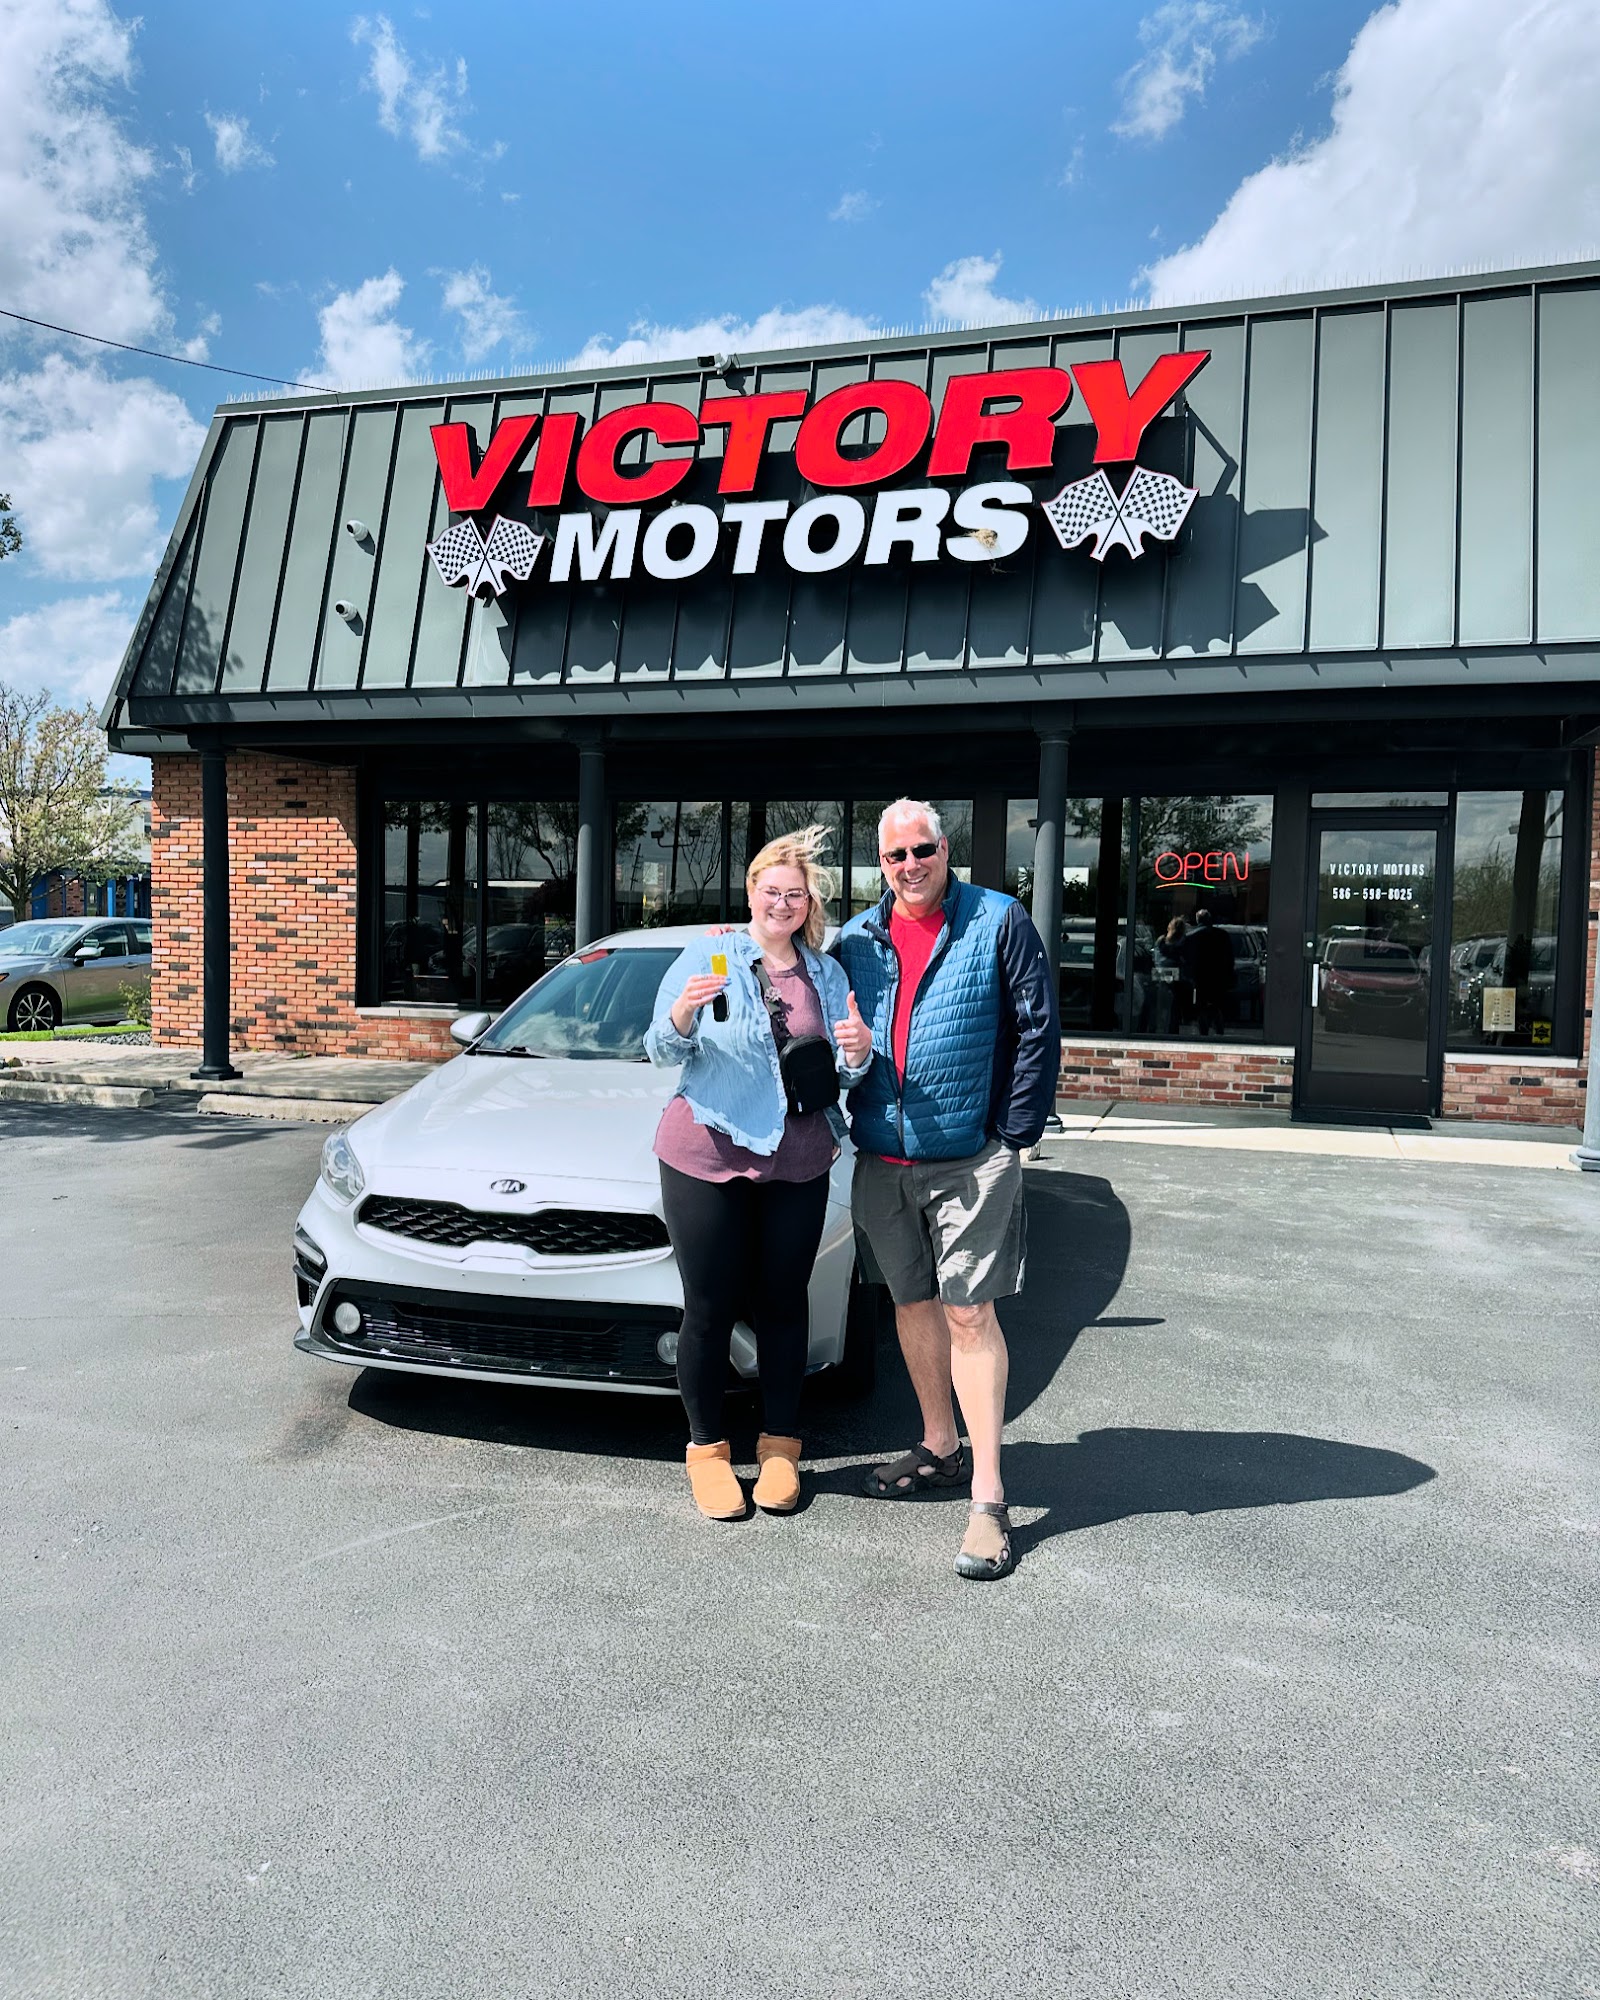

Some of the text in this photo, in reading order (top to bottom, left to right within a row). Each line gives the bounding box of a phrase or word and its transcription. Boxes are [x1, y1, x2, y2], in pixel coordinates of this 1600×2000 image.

[429, 349, 1212, 512] VICTORY
[549, 481, 1033, 583] MOTORS
[1155, 852, 1249, 881] OPEN
[1329, 863, 1425, 876] VICTORY MOTORS
[492, 1179, 522, 1193] KIA
